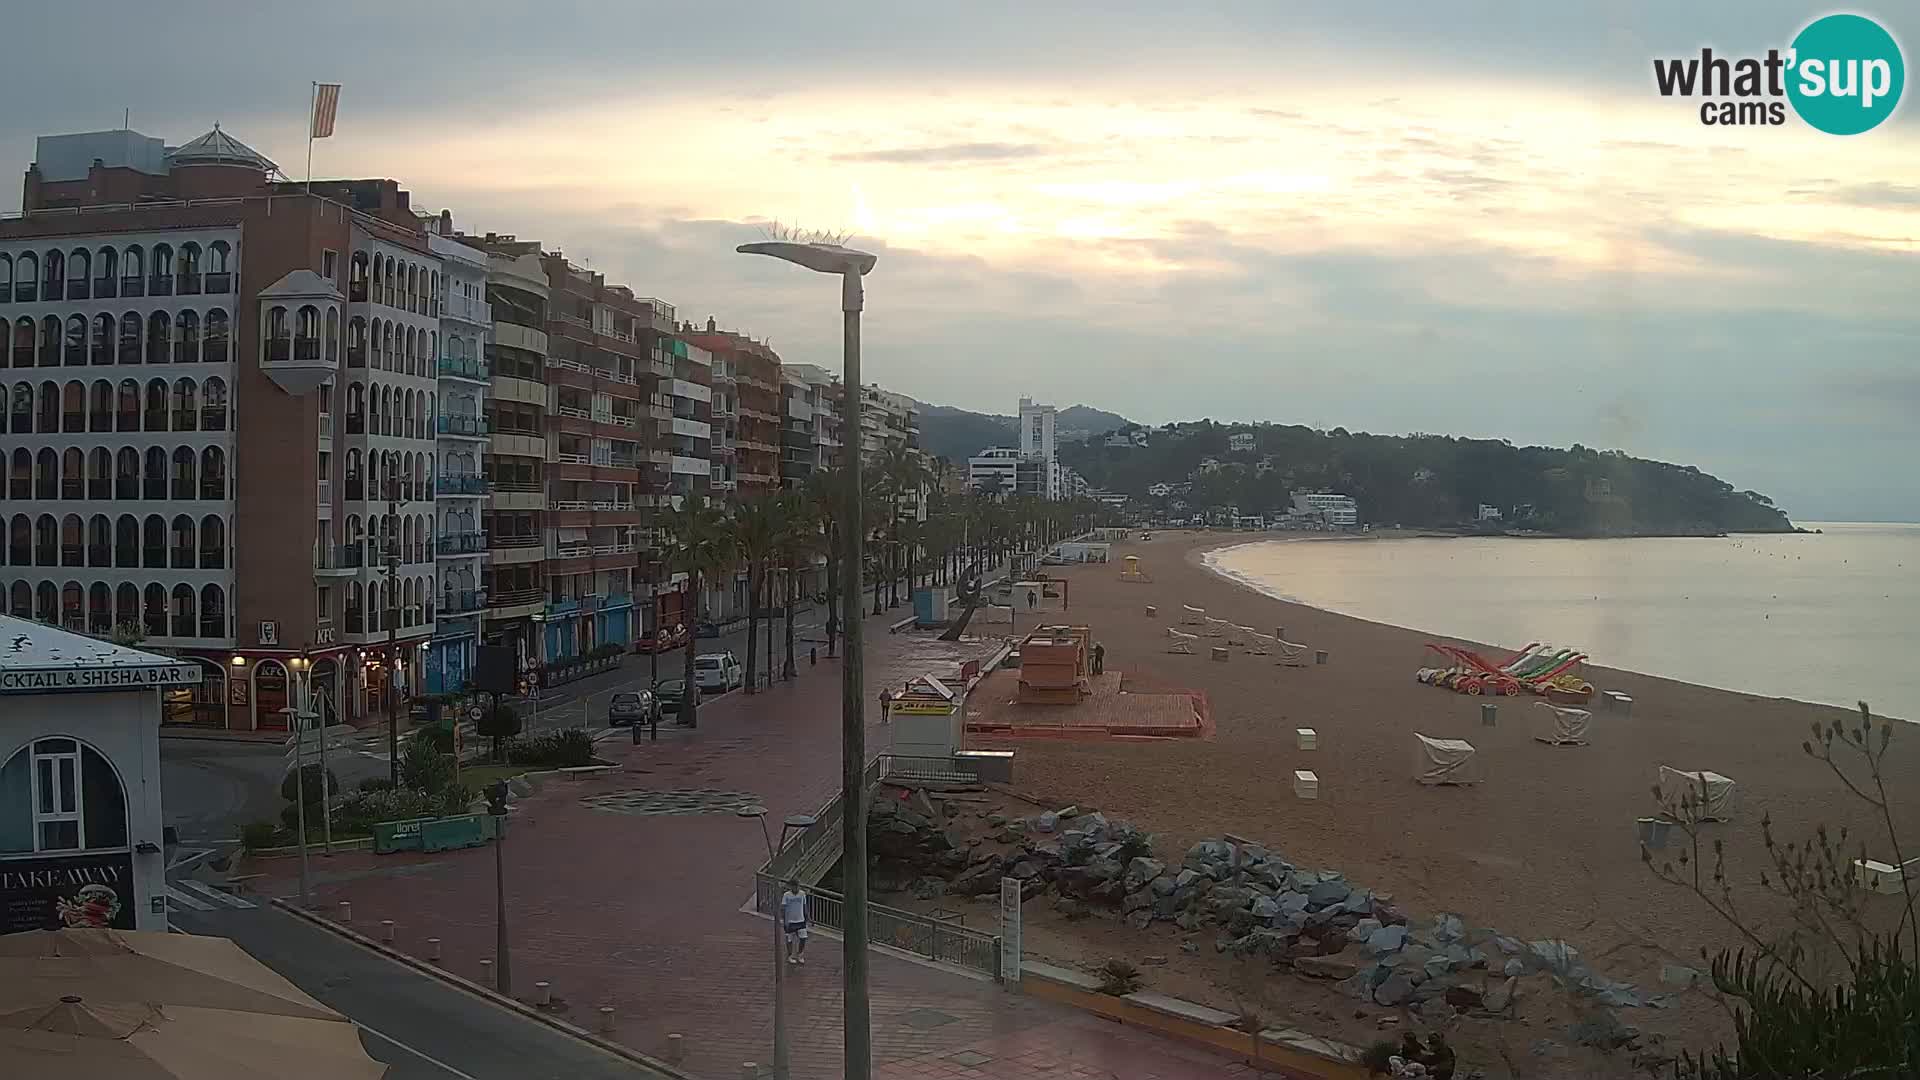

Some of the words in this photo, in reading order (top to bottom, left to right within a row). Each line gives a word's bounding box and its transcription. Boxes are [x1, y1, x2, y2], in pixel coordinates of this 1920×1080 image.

[317, 627, 336, 644] KFC
[0, 672, 61, 688] CKTAIL
[67, 672, 76, 686] &
[82, 670, 143, 686] SHISHA
[148, 668, 182, 683] BAR
[261, 666, 284, 676] KFC
